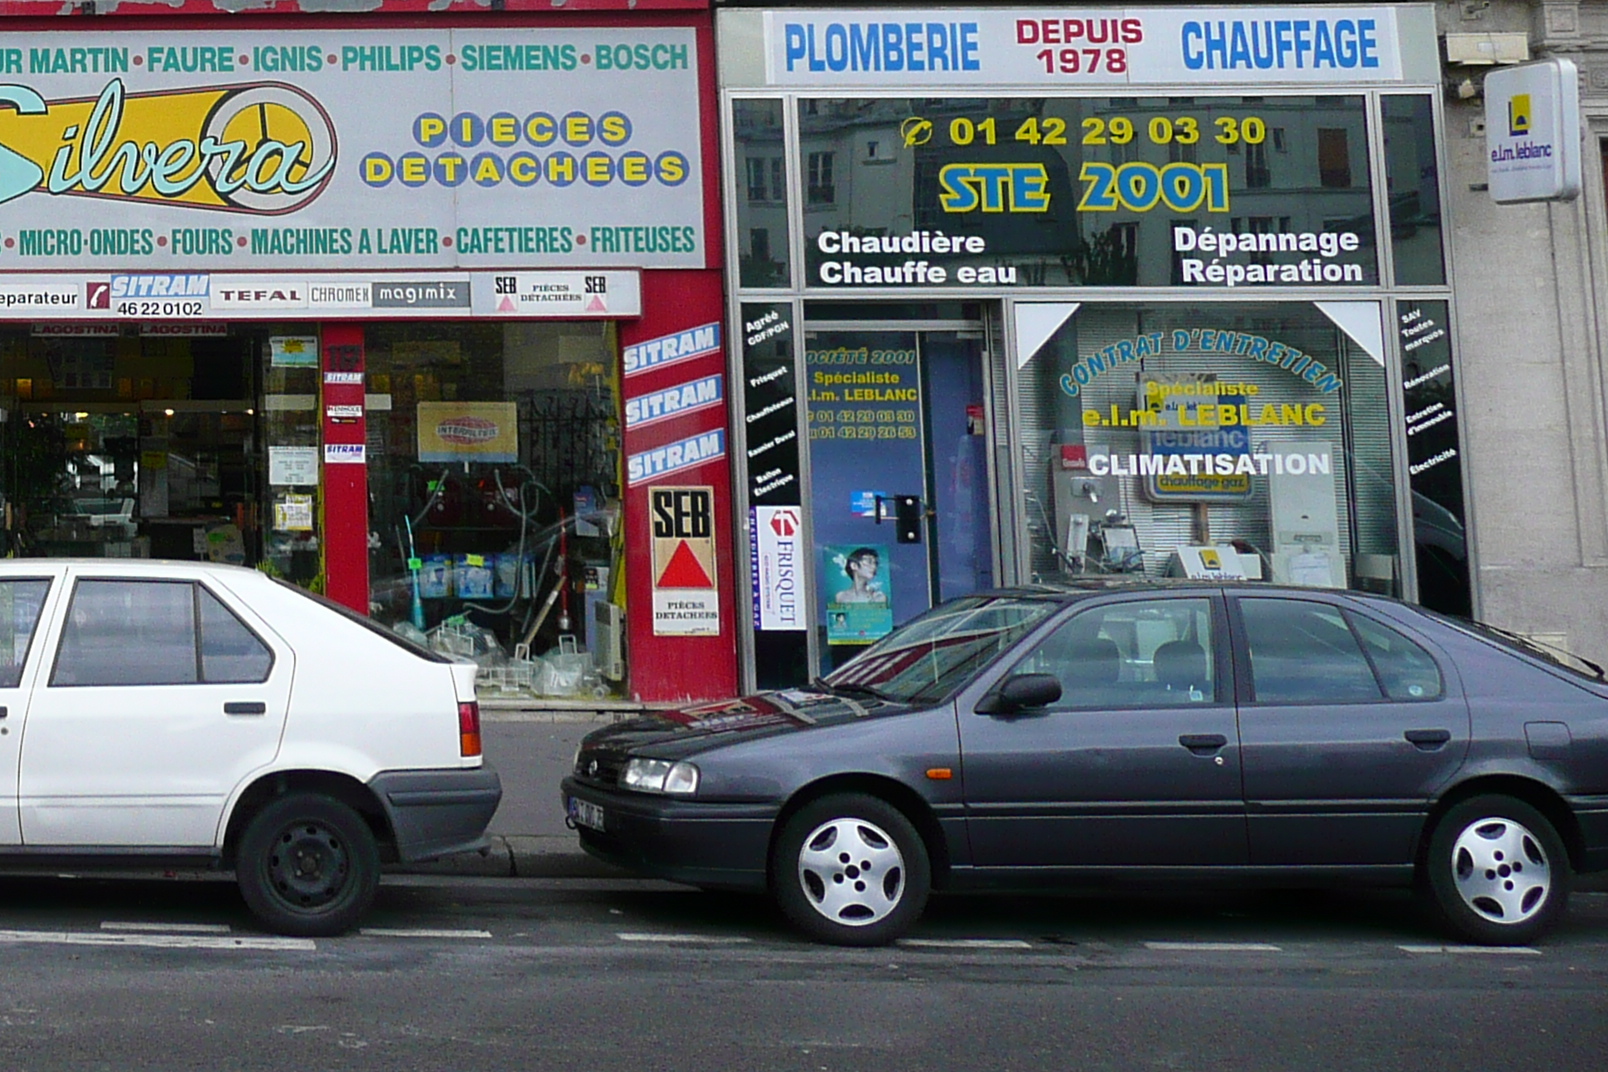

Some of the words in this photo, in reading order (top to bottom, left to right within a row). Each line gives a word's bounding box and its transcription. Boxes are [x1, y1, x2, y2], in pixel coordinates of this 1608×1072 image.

[786, 22, 980, 73] PLOMBERIE
[1016, 18, 1143, 45] DEPUIS
[1181, 18, 1379, 70] CHAUFFAGE
[30, 46, 129, 74] MARTIN
[148, 46, 235, 73] FAURE
[253, 45, 324, 72] IGNIS
[342, 44, 442, 72] PHILIPS
[461, 44, 578, 71] SIEMENS
[596, 43, 690, 71] BOSCH
[1036, 48, 1128, 75] 1978
[416, 114, 630, 145] PIECES
[949, 117, 997, 146] 01
[1015, 117, 1067, 146] 42
[1081, 117, 1134, 145] 29
[1147, 116, 1200, 145] 03
[1214, 116, 1266, 145] 30
[363, 154, 686, 184] DETACHEES
[938, 162, 1050, 213] STE
[1078, 162, 1230, 213] 2001
[172, 229, 234, 256] FOURS
[251, 228, 353, 255] MACHINES
[358, 228, 372, 254] A
[378, 227, 439, 254] LAVER
[456, 227, 574, 254] CAFETIERES
[591, 225, 696, 253] FRITEUSES
[817, 229, 986, 255] Chaudière
[1173, 225, 1359, 260] Dépannage
[818, 258, 952, 285] Chauffe
[957, 264, 1017, 285] eau
[1182, 254, 1364, 289] Réparation
[111, 275, 209, 297] SITRAM
[219, 289, 302, 302] TEFAL
[379, 282, 457, 304] magimix
[495, 276, 517, 294] SEB
[584, 275, 606, 293] SEB
[117, 301, 138, 316] 46
[141, 301, 160, 316] 22
[1402, 309, 1421, 324] SAV
[32, 324, 120, 335] LAGOSTINA
[140, 324, 228, 335] LAGOSTINA
[1402, 319, 1435, 338] Toutes
[1405, 329, 1445, 352] marques
[624, 326, 715, 372] SITRAM
[806, 347, 868, 364] OCIÉTÉ
[871, 349, 915, 365] 2001
[1059, 331, 1165, 398] CONTRAT
[1172, 328, 1345, 395] D'ENTRETIEN
[750, 366, 789, 388] Frisquet
[814, 371, 901, 387] Spécialiste
[1145, 380, 1259, 398] Spécialiste
[1404, 363, 1450, 390] Rénovation
[625, 378, 717, 426] SITRAM
[807, 389, 840, 402] .l.m.
[844, 389, 918, 402] LEBLANC
[817, 410, 834, 423] 01
[837, 410, 855, 423] 42
[1082, 404, 1168, 426] e.l.m.
[1178, 403, 1327, 426] LEBLANC
[1405, 402, 1445, 424] Entretien
[774, 430, 796, 445] Duval
[838, 426, 856, 439] 42
[327, 445, 363, 454] SITRAM
[628, 433, 720, 482] SITRAM
[1088, 453, 1331, 476] CLIMATISATION
[653, 489, 712, 539] SEB
[775, 540, 796, 625] FRISQUET
